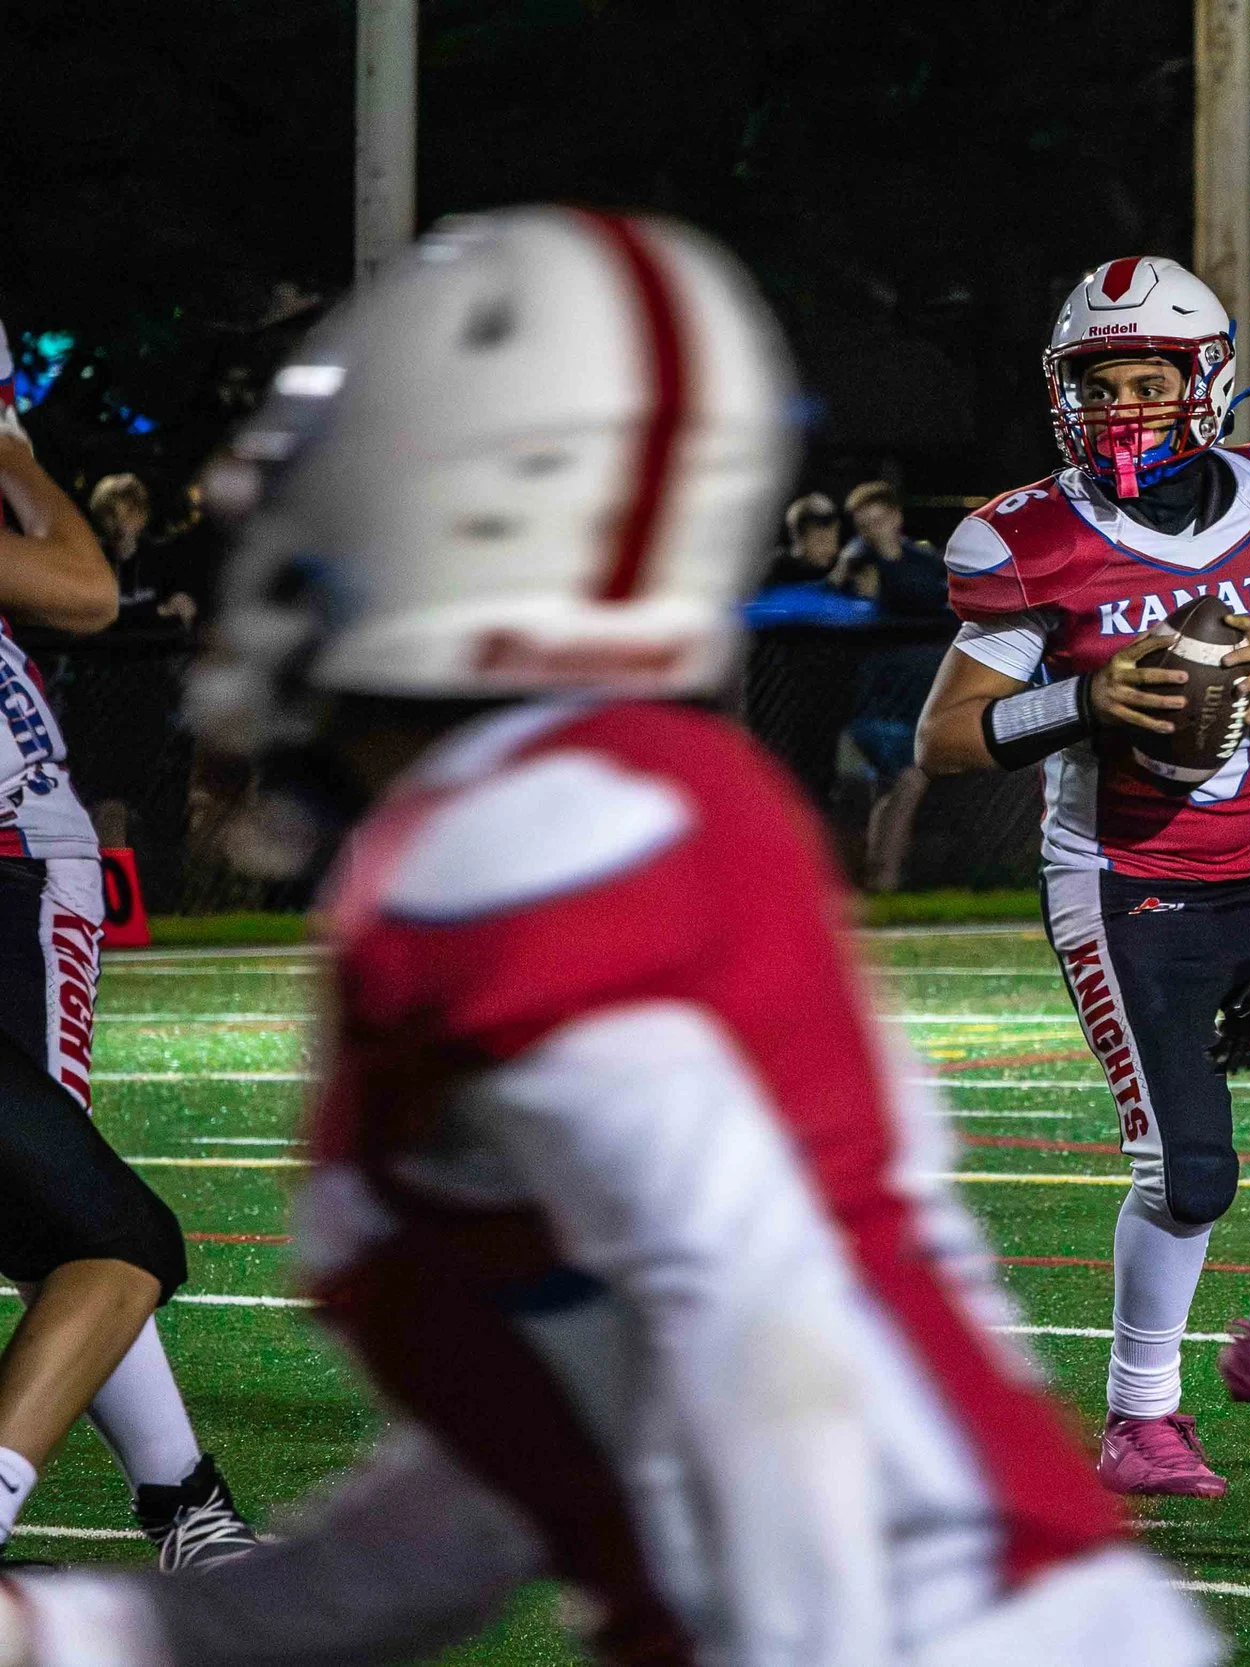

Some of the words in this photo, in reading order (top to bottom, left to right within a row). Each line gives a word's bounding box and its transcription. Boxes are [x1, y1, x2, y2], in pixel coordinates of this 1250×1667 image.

[1088, 322, 1138, 337] Riddell
[995, 489, 1049, 515] 6
[1067, 939, 1149, 1143] KNIGHTS
